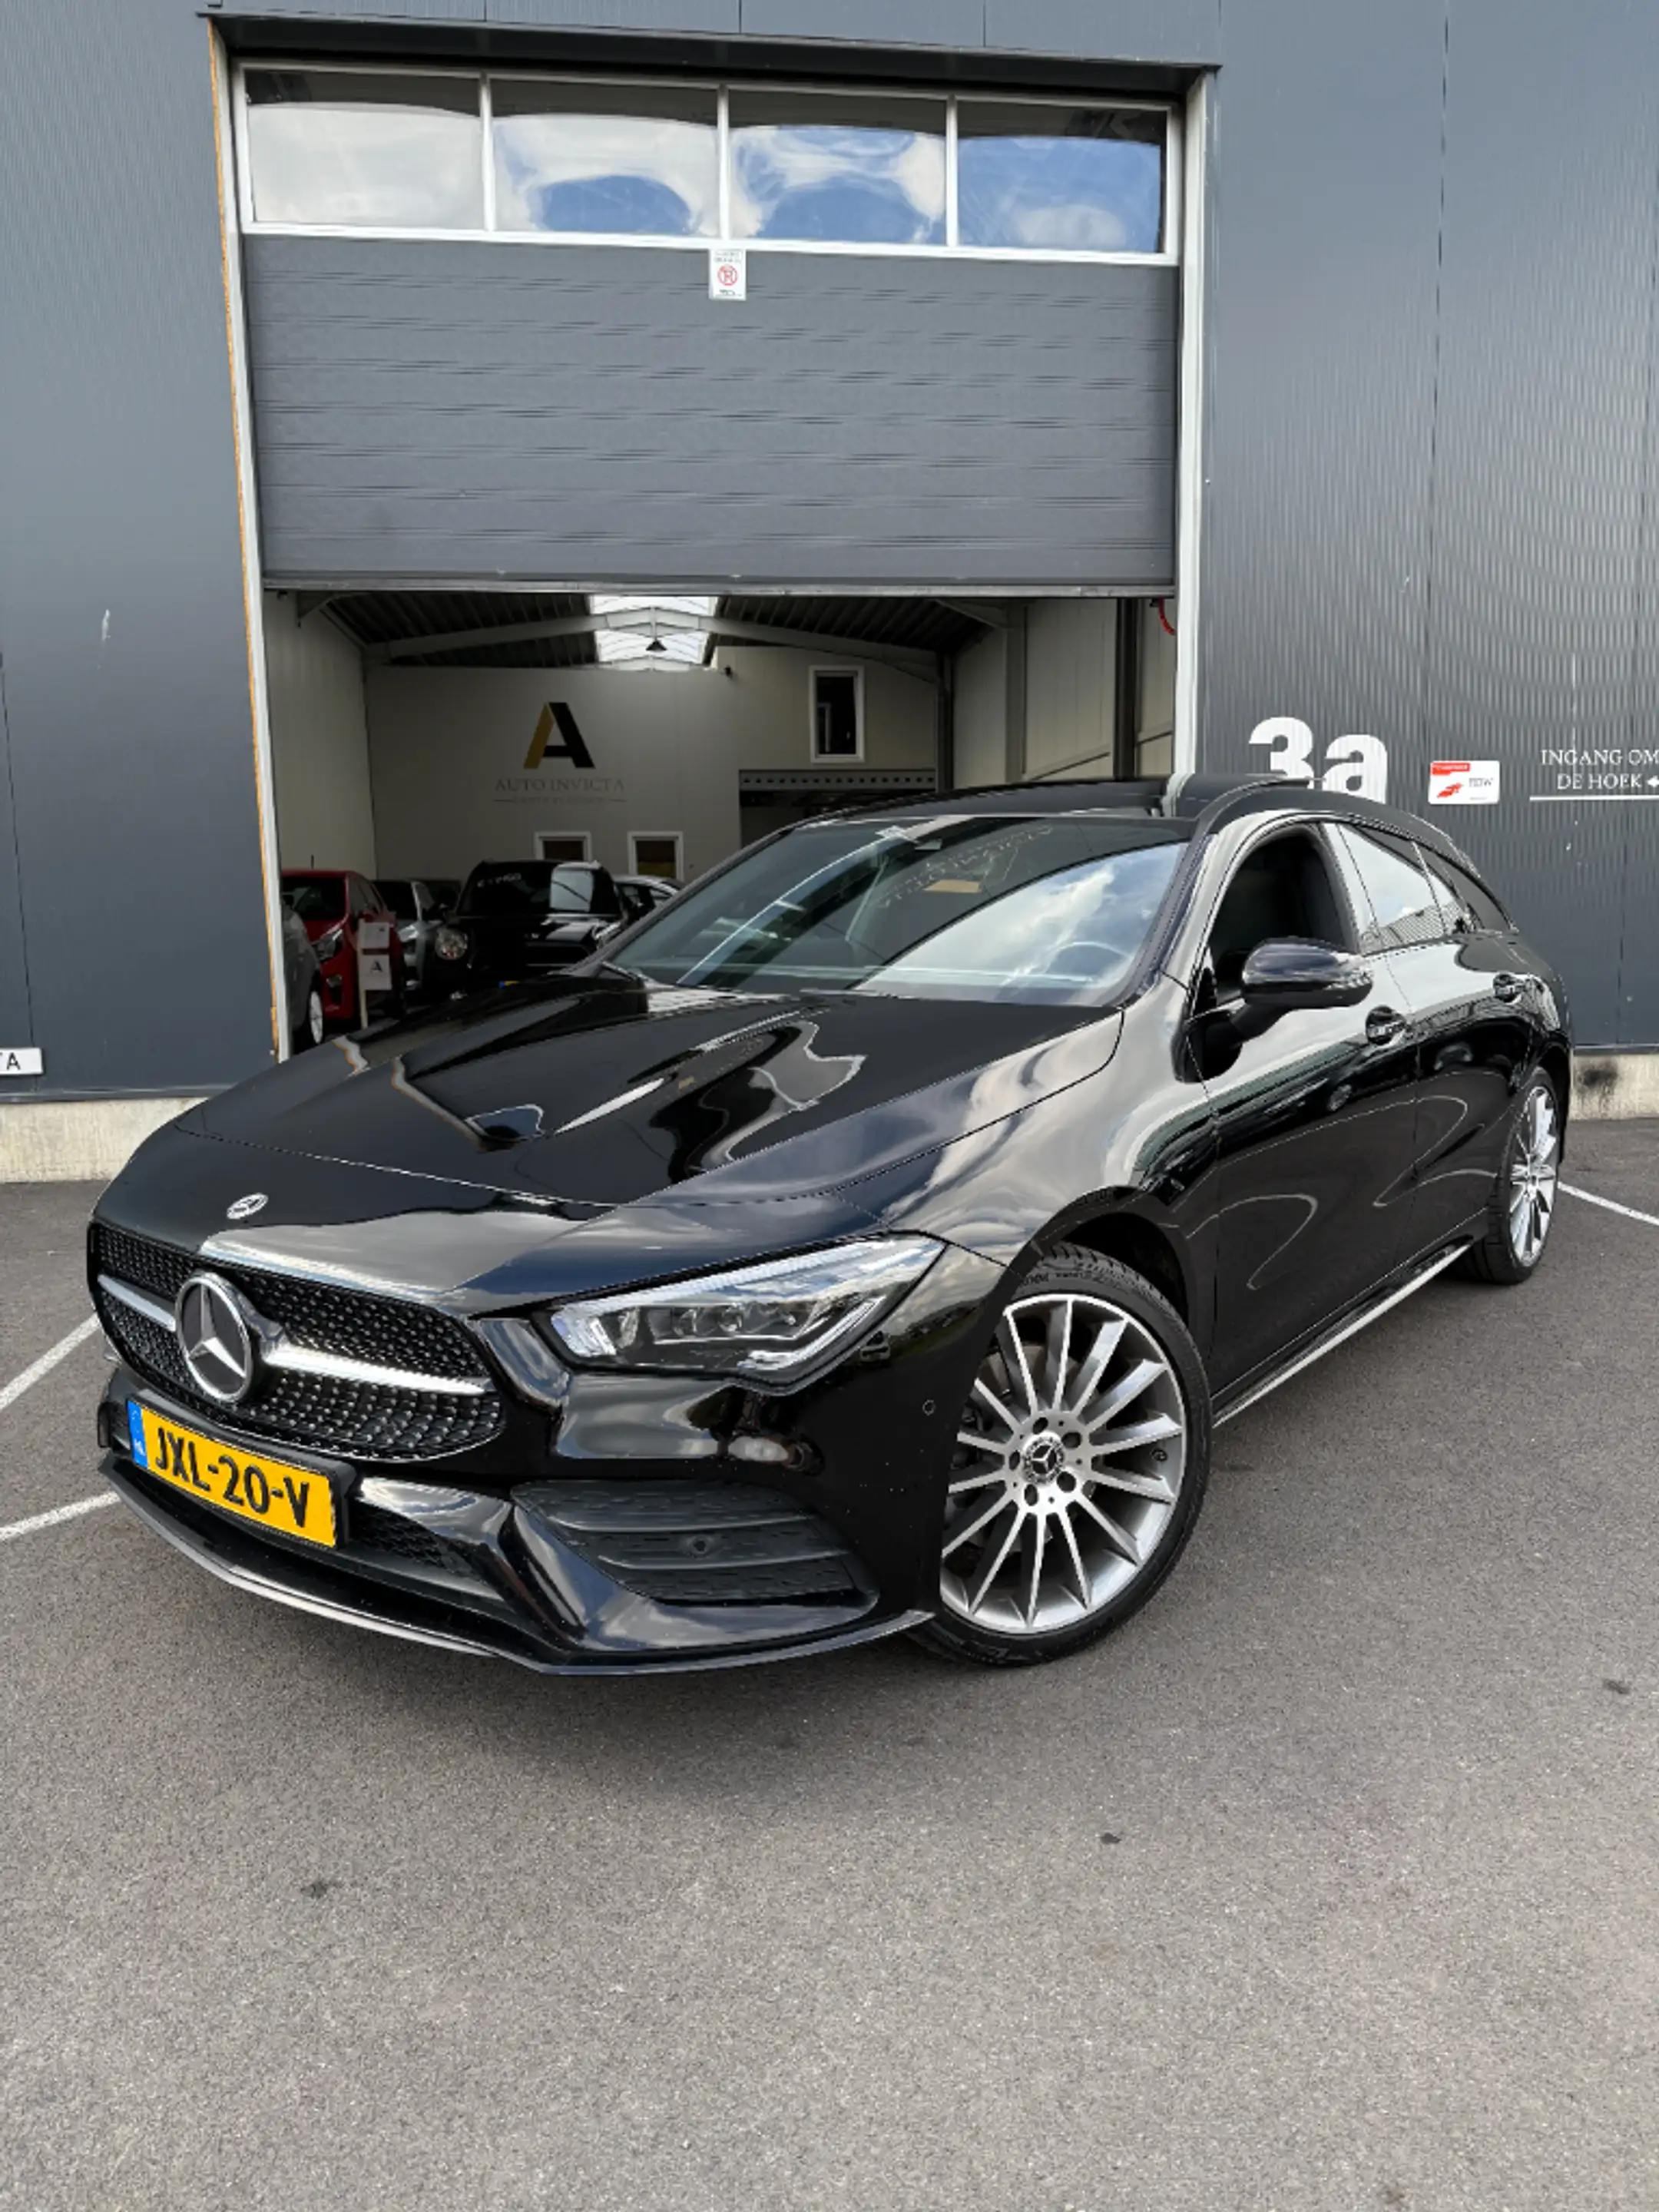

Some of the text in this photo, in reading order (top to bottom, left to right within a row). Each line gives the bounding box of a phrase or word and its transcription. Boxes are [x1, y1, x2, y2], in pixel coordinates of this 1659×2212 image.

[524, 701, 596, 769] A
[1247, 716, 1388, 804] 3a
[1541, 750, 1659, 766] INGANG OM
[495, 778, 624, 792] AUTO INVICTA
[1557, 773, 1643, 790] DE HOEK
[0, 1052, 21, 1071] A
[155, 1427, 310, 1528] JXL-20-V
